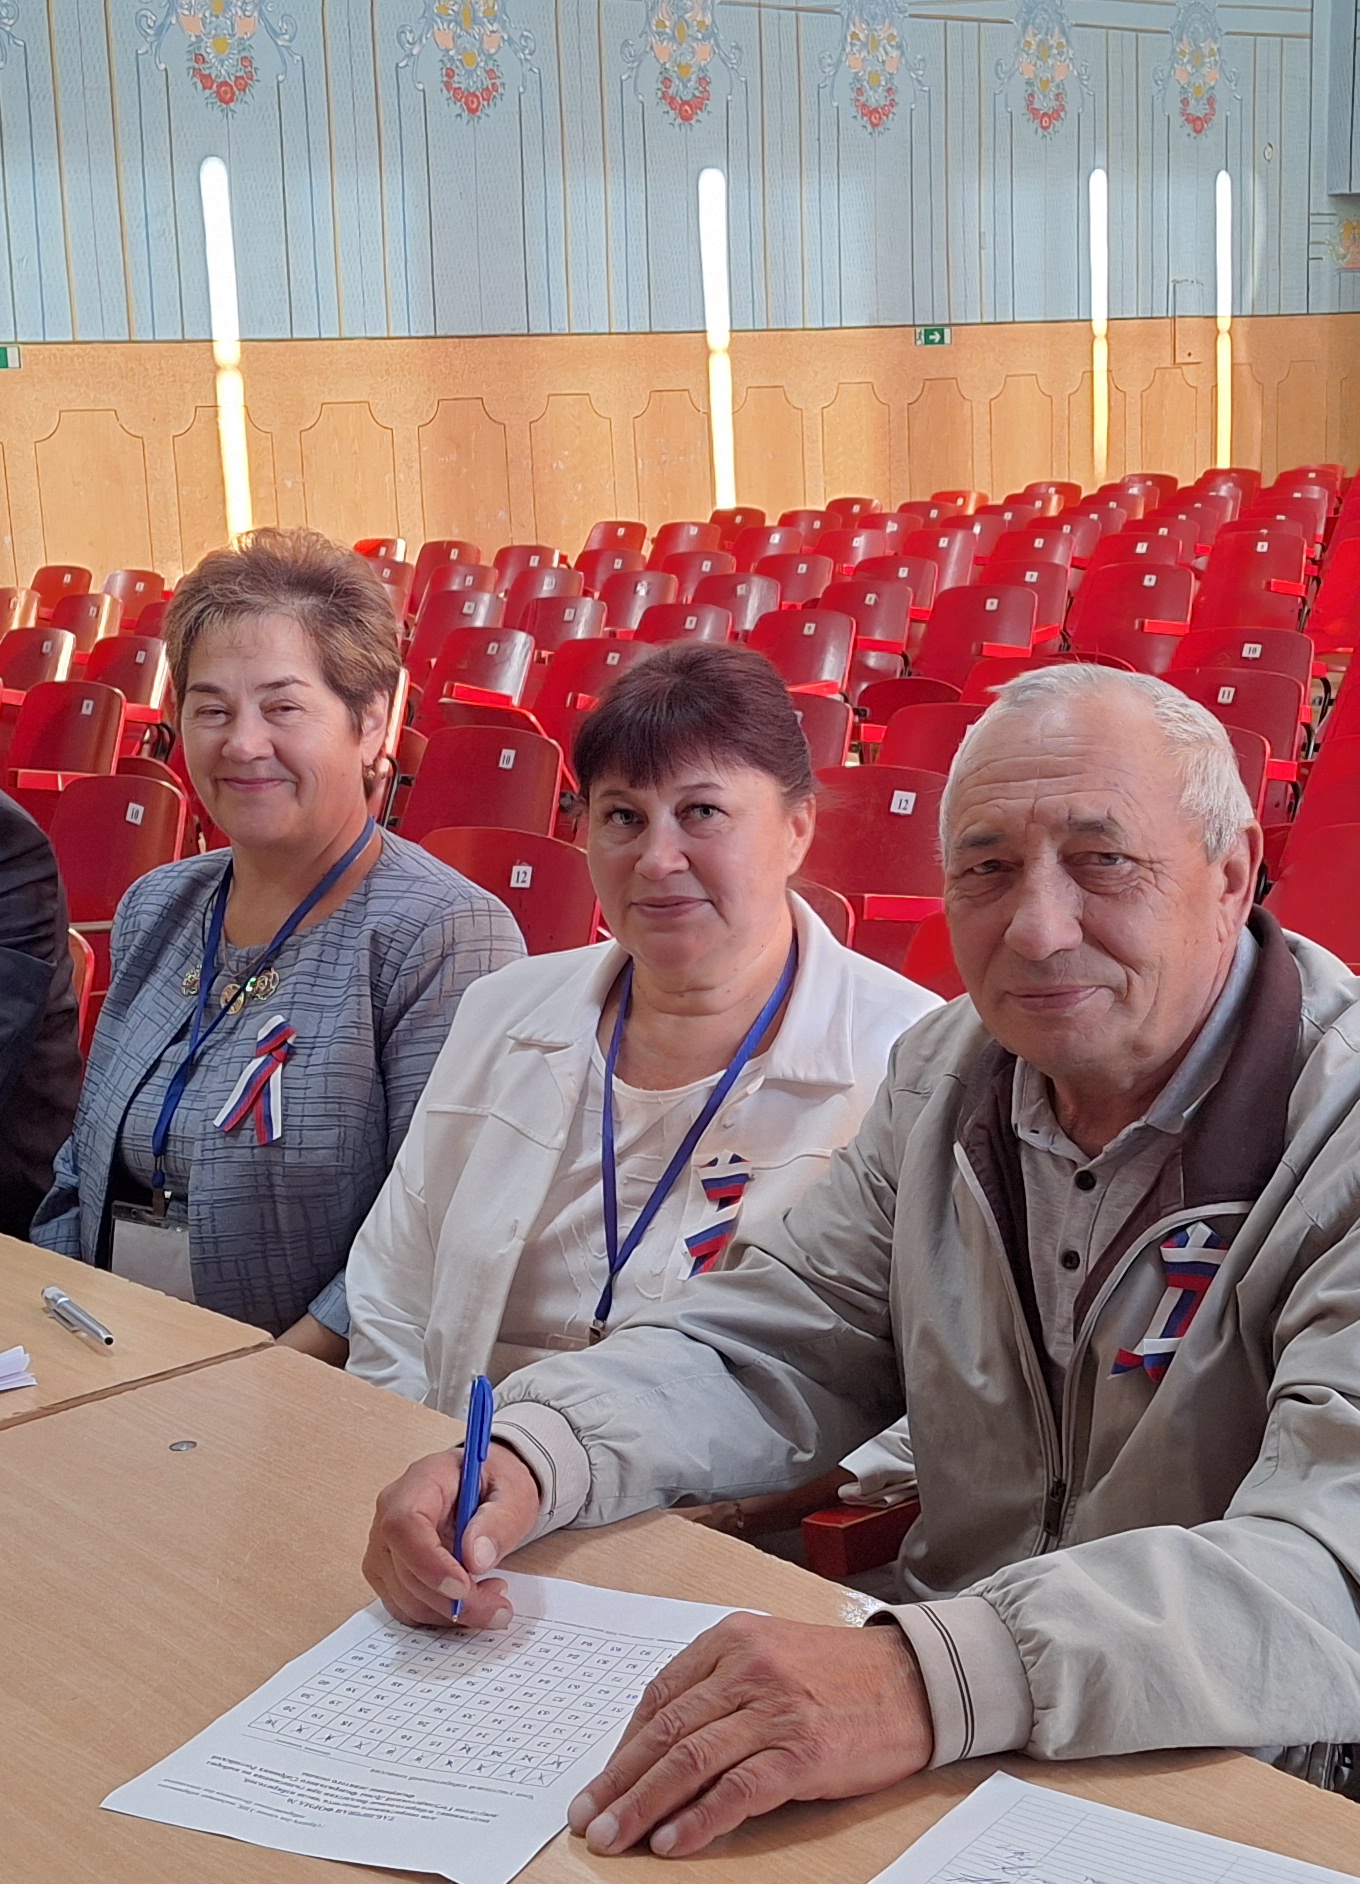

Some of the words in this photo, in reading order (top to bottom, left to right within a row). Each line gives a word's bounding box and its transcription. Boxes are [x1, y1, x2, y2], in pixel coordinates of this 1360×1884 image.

[1248, 646, 1258, 655] 10
[1221, 690, 1231, 700] 11
[501, 754, 511, 766] 10
[897, 798, 909, 811] 12
[130, 807, 140, 821] 10
[515, 870, 528, 884] 12
